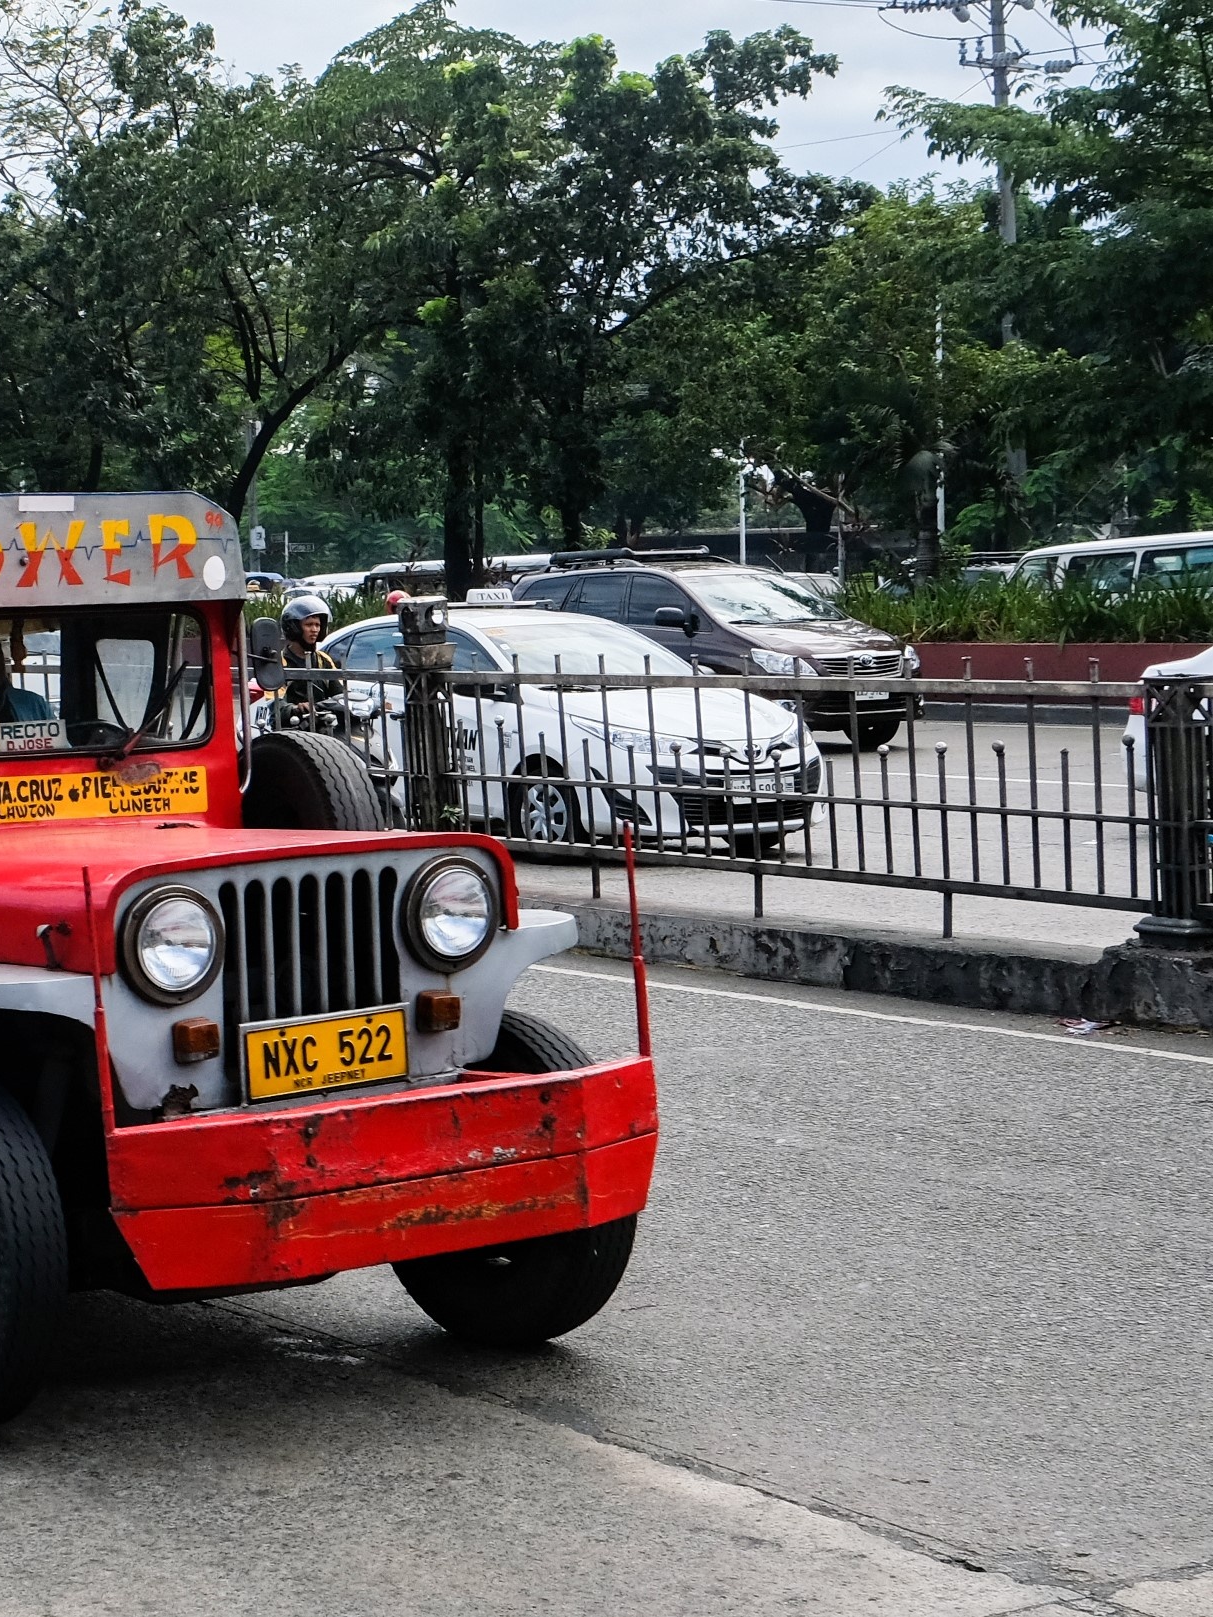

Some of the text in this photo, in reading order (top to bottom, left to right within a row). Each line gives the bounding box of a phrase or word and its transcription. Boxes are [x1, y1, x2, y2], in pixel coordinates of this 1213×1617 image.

[478, 592, 507, 601] TAXI
[1, 722, 60, 740] RECTO
[109, 797, 171, 814] LUNETA
[263, 1023, 393, 1080] NXC 522
[293, 1068, 366, 1089] NCR JEEPNEY
